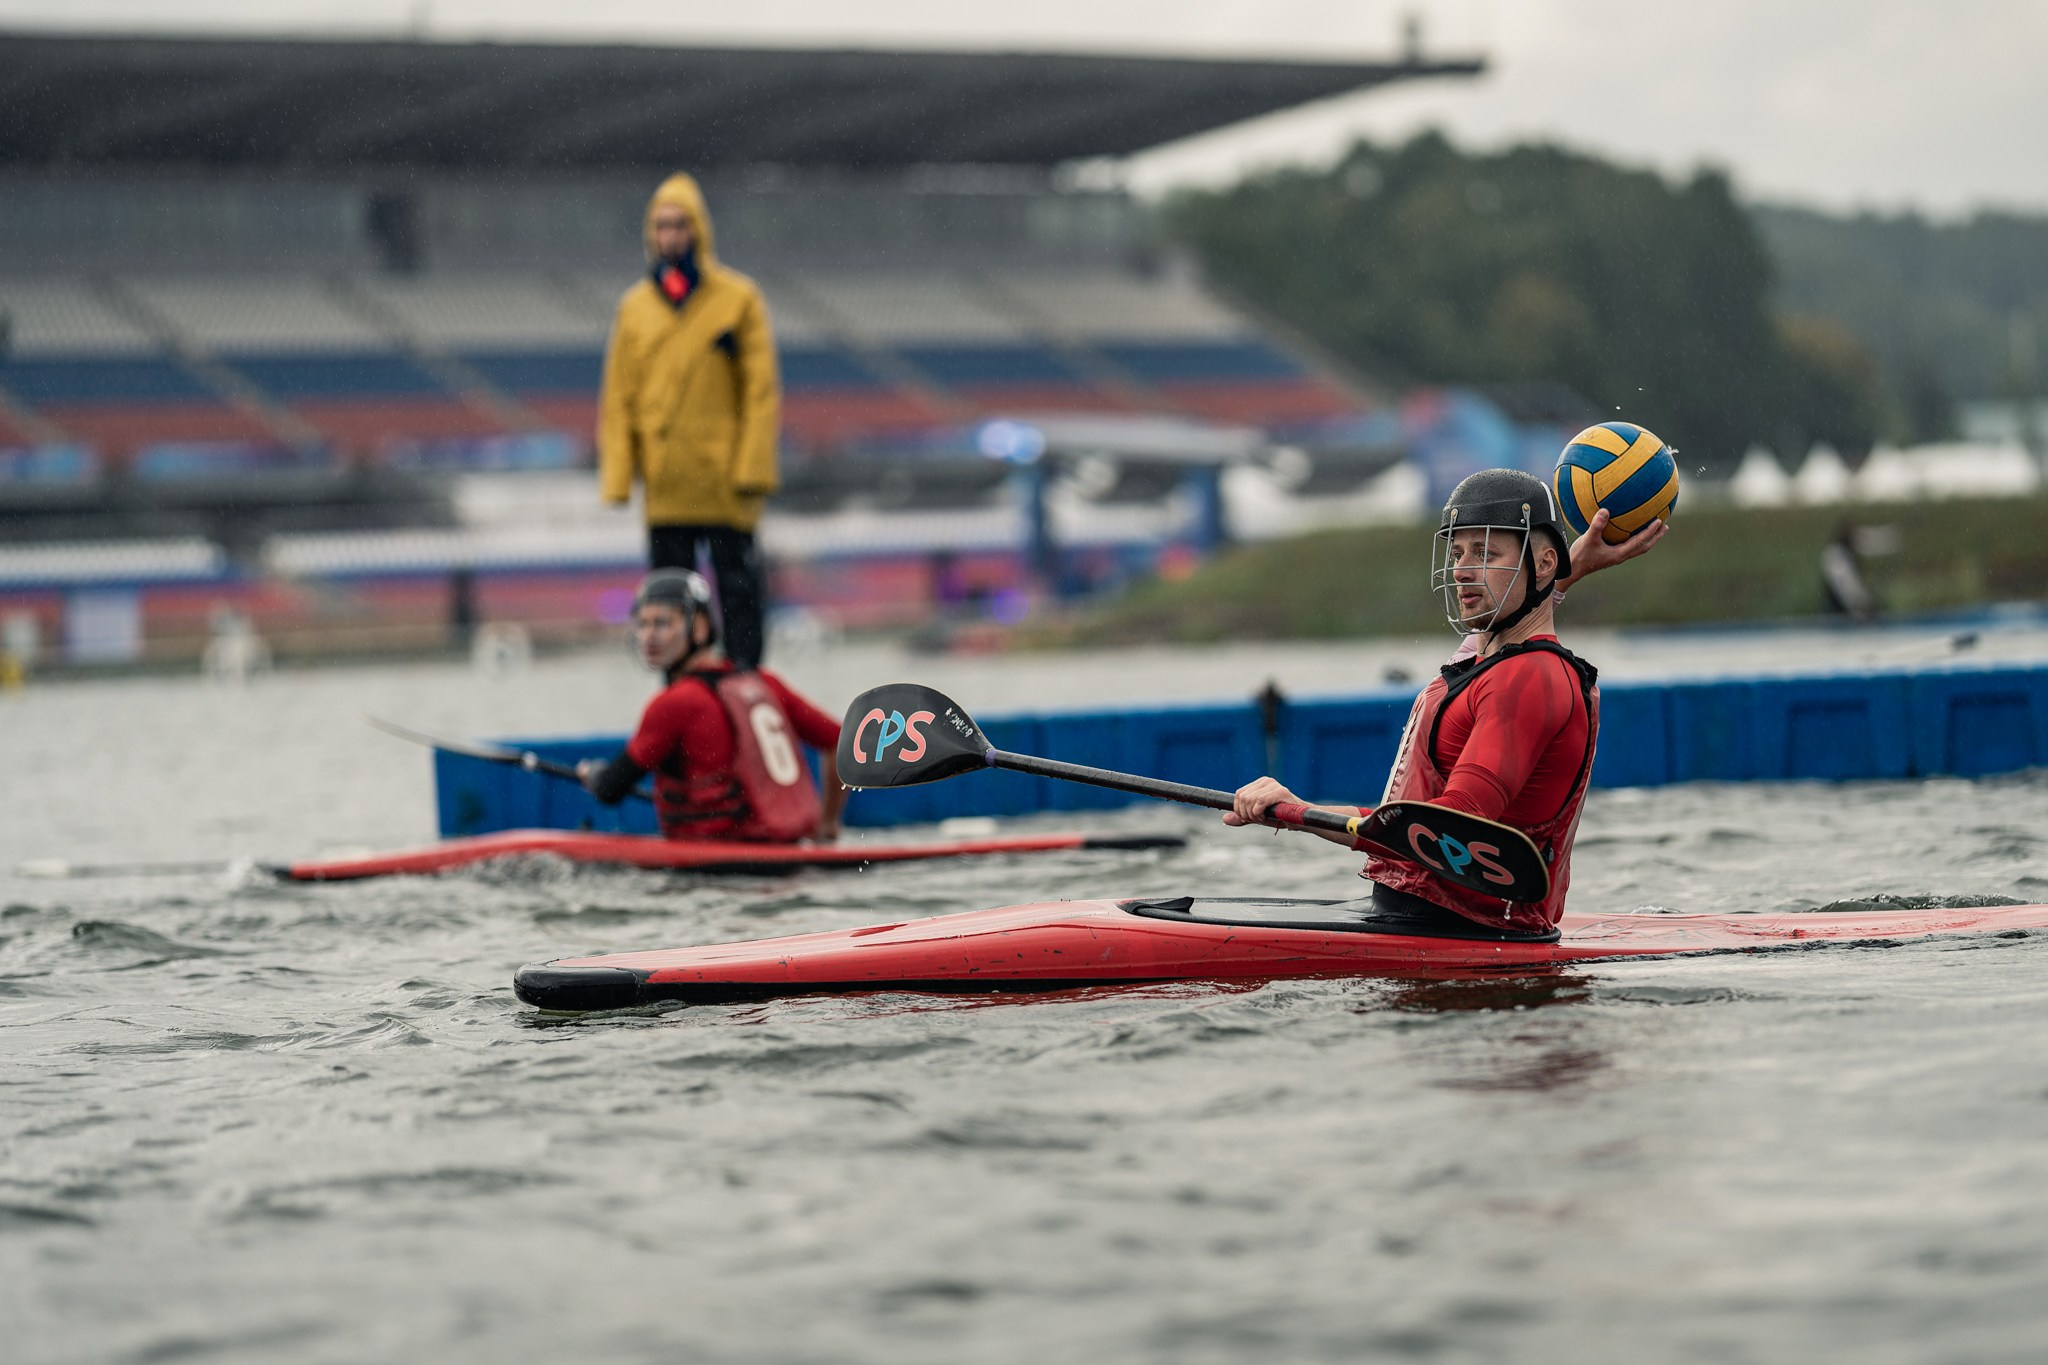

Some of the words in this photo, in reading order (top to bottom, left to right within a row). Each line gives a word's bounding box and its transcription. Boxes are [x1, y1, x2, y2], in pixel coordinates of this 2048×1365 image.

[751, 702, 798, 786] 6
[853, 708, 936, 764] CPS
[1407, 823, 1515, 885] CPS
